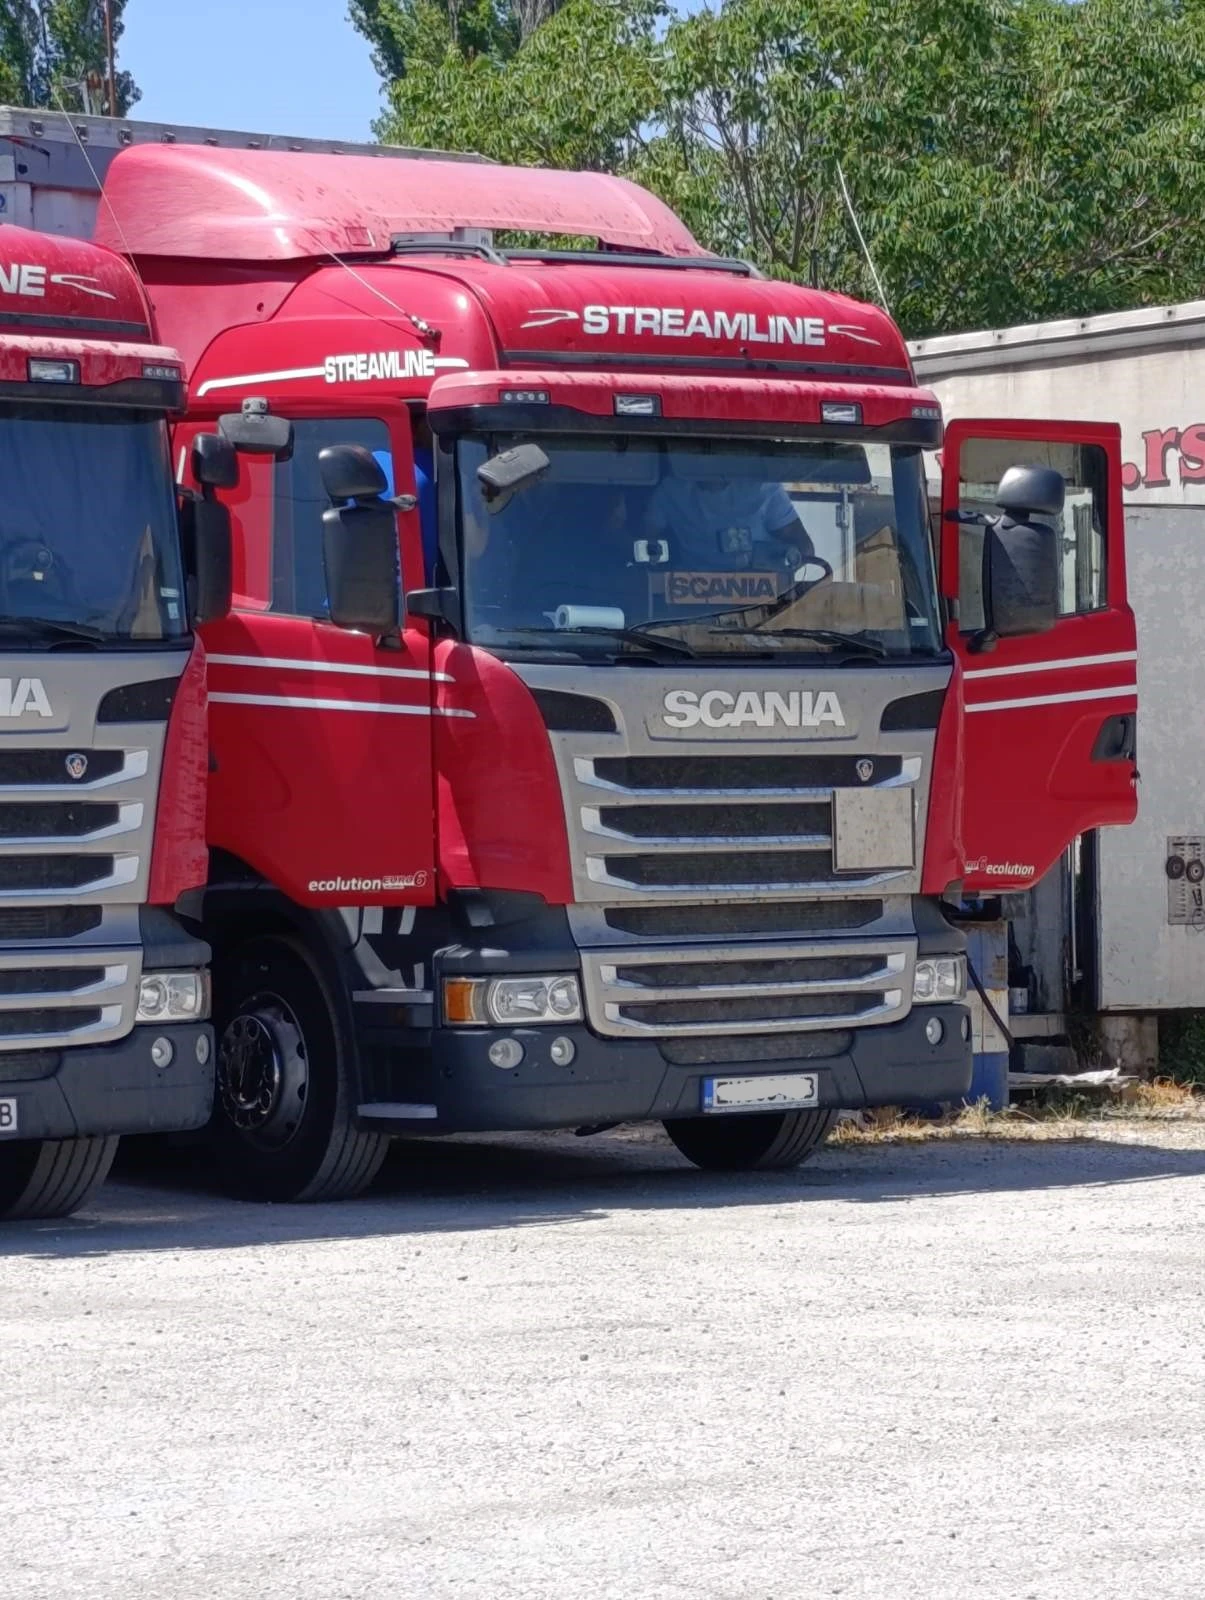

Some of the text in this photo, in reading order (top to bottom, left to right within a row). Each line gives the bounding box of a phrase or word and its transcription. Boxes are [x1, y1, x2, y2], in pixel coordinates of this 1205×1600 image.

[583, 305, 826, 346] STREAMLINE
[325, 350, 435, 383] STREAMLINE
[671, 577, 777, 599] SCANIA
[663, 690, 846, 728] SCANIA
[986, 861, 1035, 876] ecolution
[308, 876, 381, 891] ecolution
